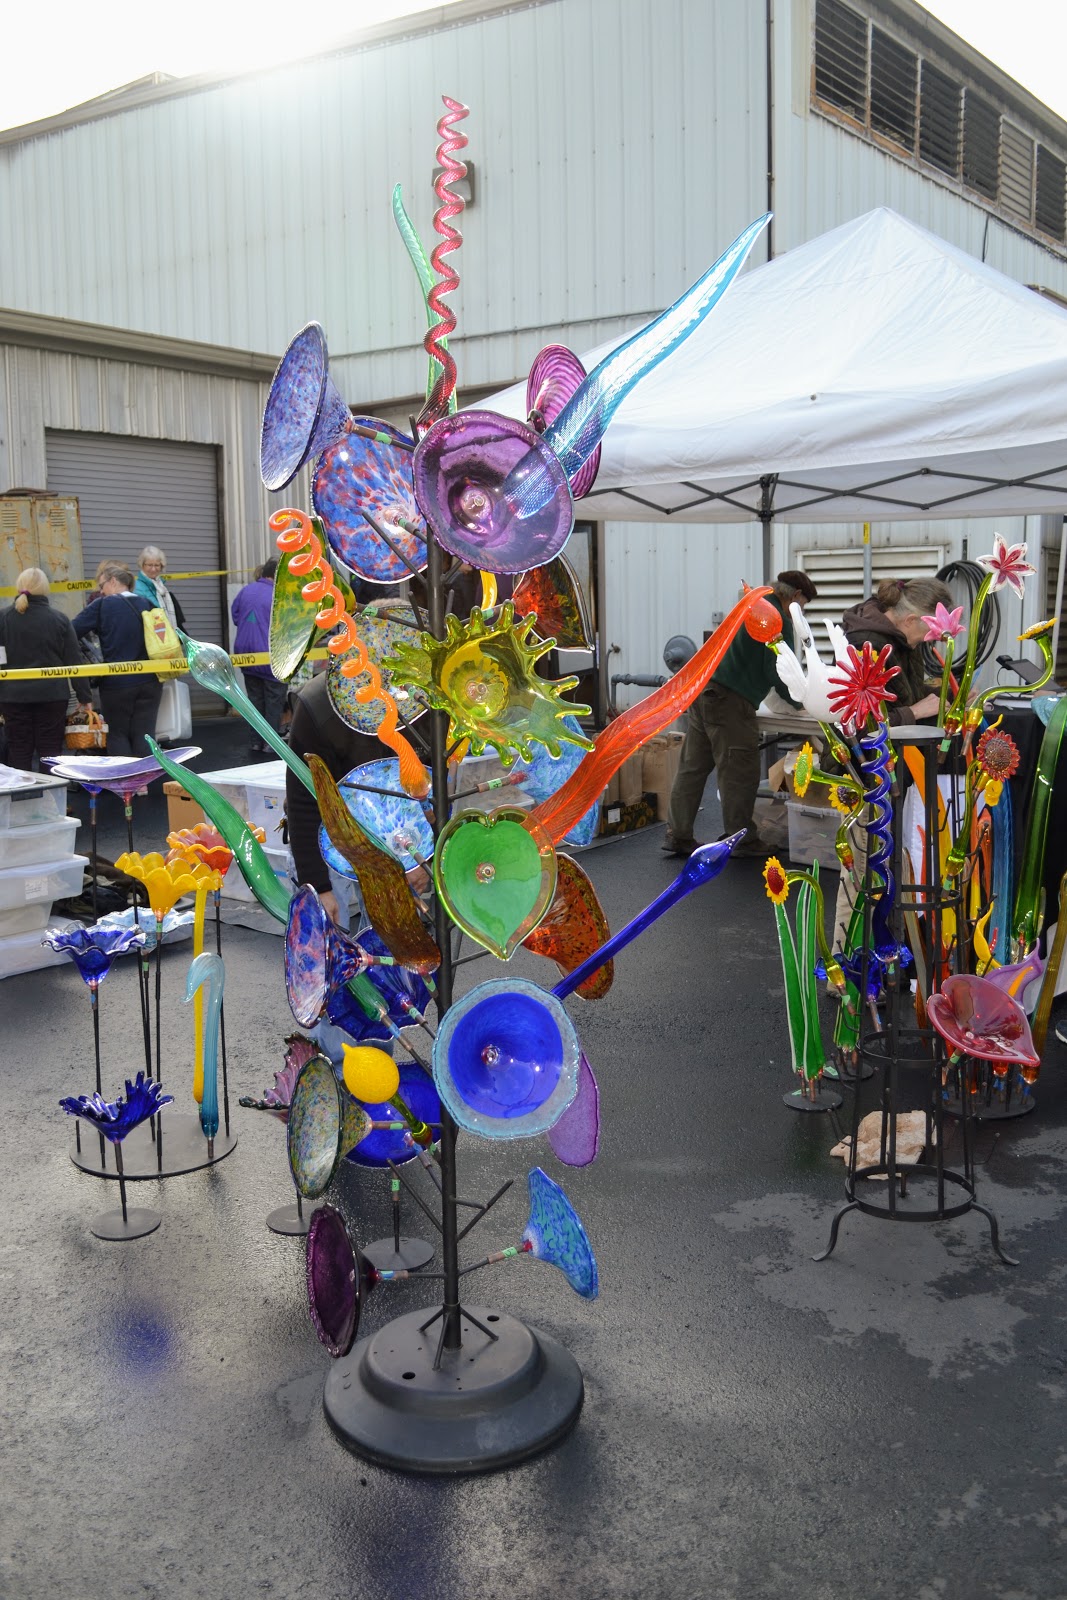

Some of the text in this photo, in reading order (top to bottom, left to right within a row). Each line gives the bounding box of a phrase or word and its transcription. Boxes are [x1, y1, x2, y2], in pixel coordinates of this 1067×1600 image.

[67, 581, 92, 590] CAUTION
[170, 660, 188, 669] TION
[232, 654, 255, 665] CAUTIO
[108, 662, 143, 673] CAUTION
